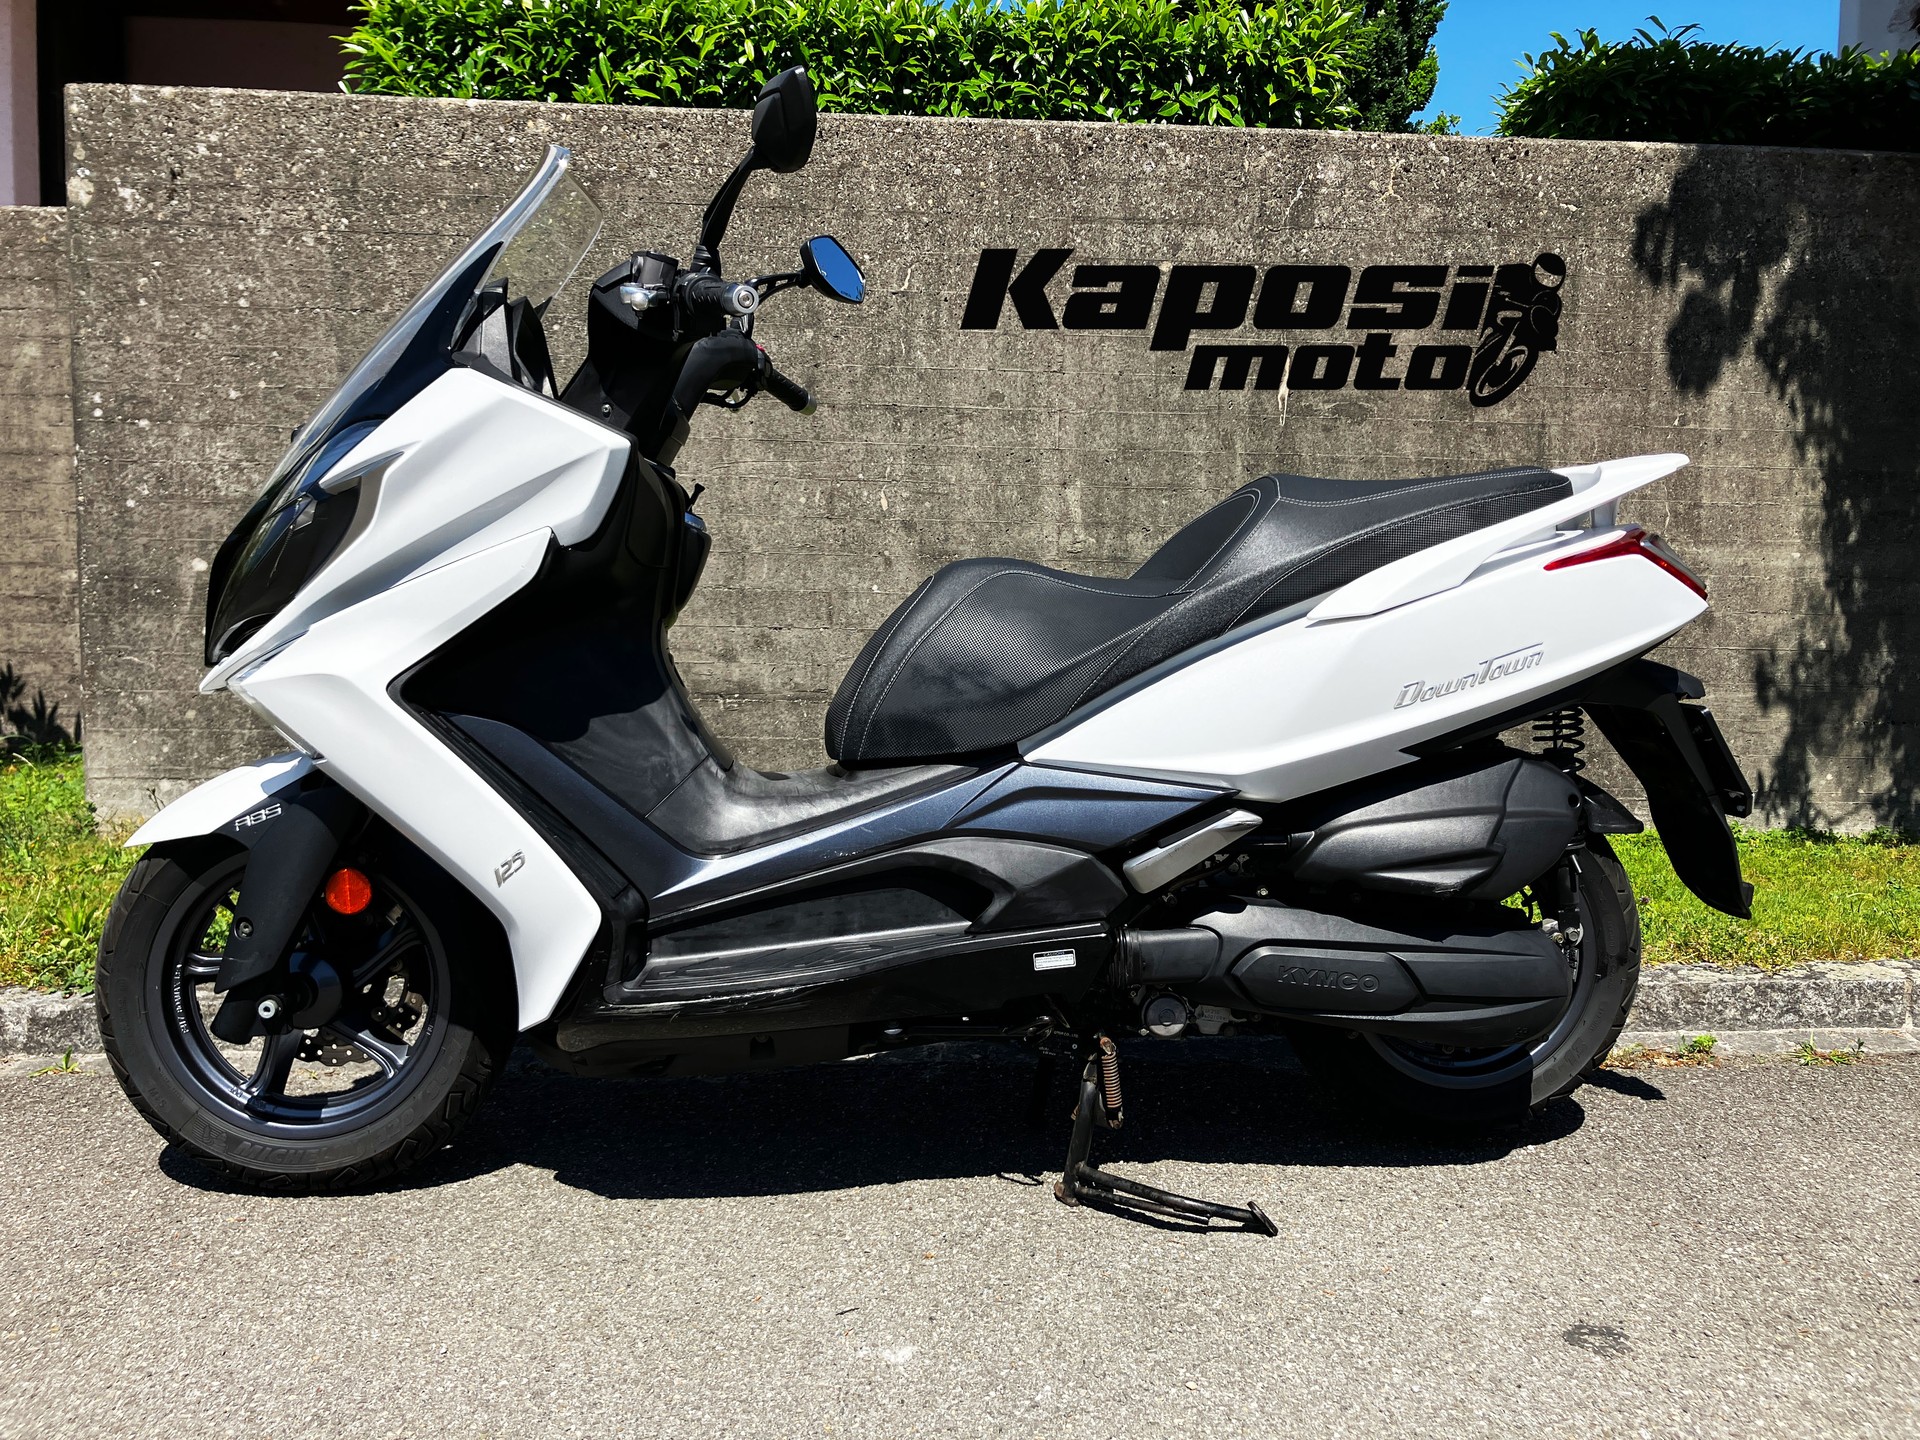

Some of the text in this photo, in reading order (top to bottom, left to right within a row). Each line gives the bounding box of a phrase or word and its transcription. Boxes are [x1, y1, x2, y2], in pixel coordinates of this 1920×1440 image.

[960, 248, 1495, 351] Kaposi
[1184, 333, 1473, 391] moto
[1394, 642, 1544, 709] DownTown
[235, 803, 281, 831] ABS
[494, 850, 526, 888] 125
[1277, 965, 1380, 993] KYMCO
[234, 1138, 363, 1166] MICHEL
